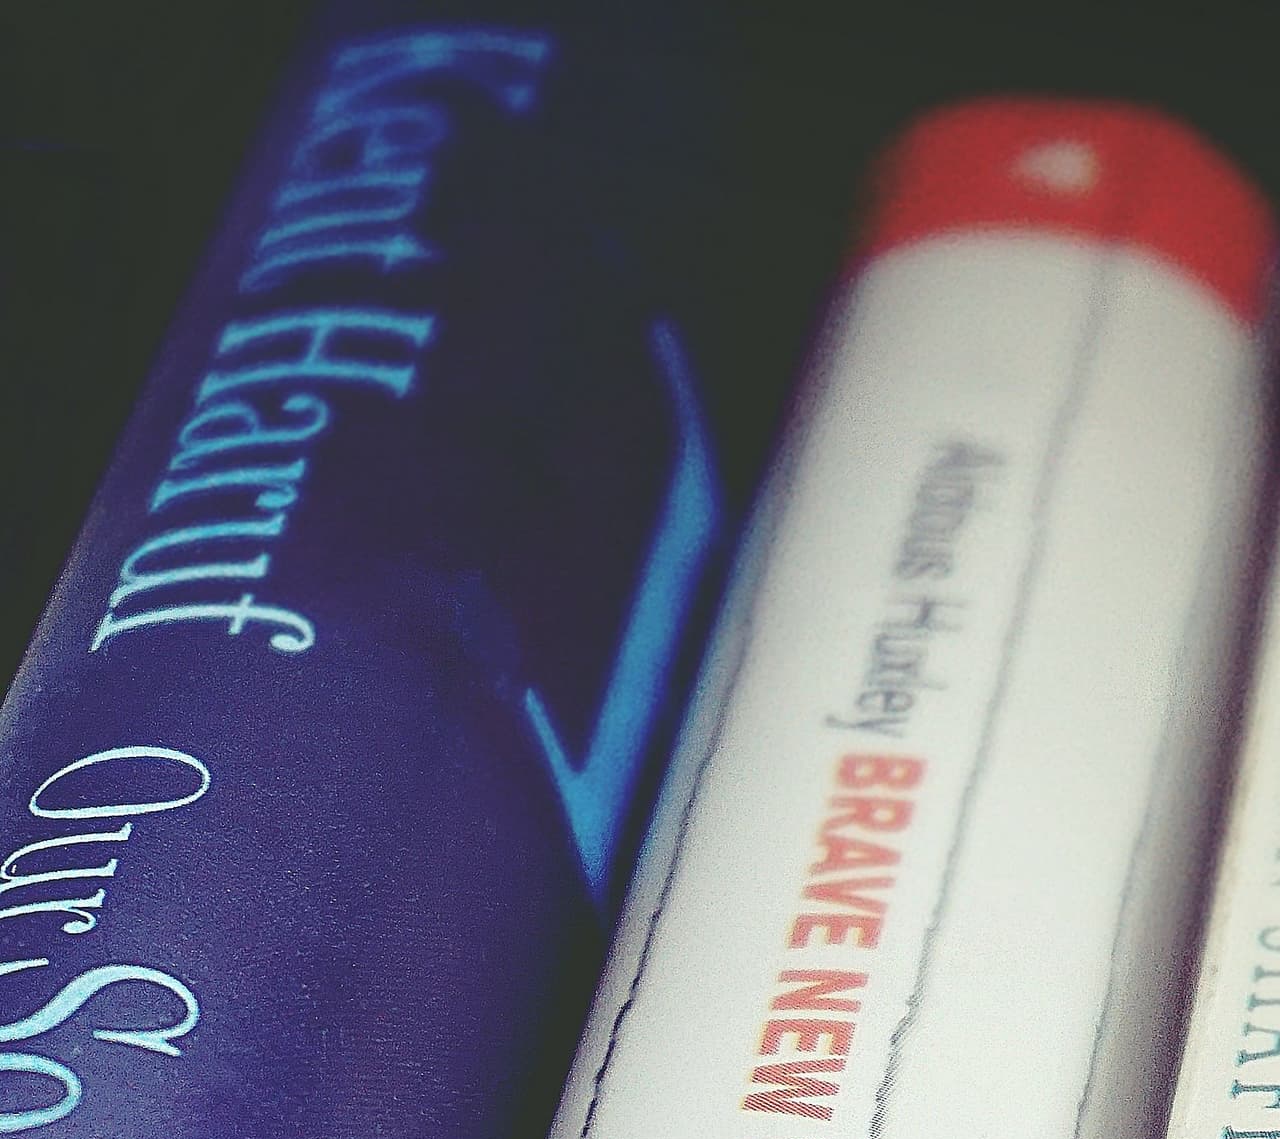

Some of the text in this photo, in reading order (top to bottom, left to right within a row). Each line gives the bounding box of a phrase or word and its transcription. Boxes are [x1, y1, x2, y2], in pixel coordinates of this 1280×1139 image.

[238, 27, 550, 293] Kent
[89, 308, 435, 653] Haruf
[896, 436, 1003, 580] Aldous
[824, 593, 966, 736] Huxley
[0, 745, 211, 934] Our
[786, 753, 927, 950] BRAVE
[740, 968, 869, 1121] NEW
